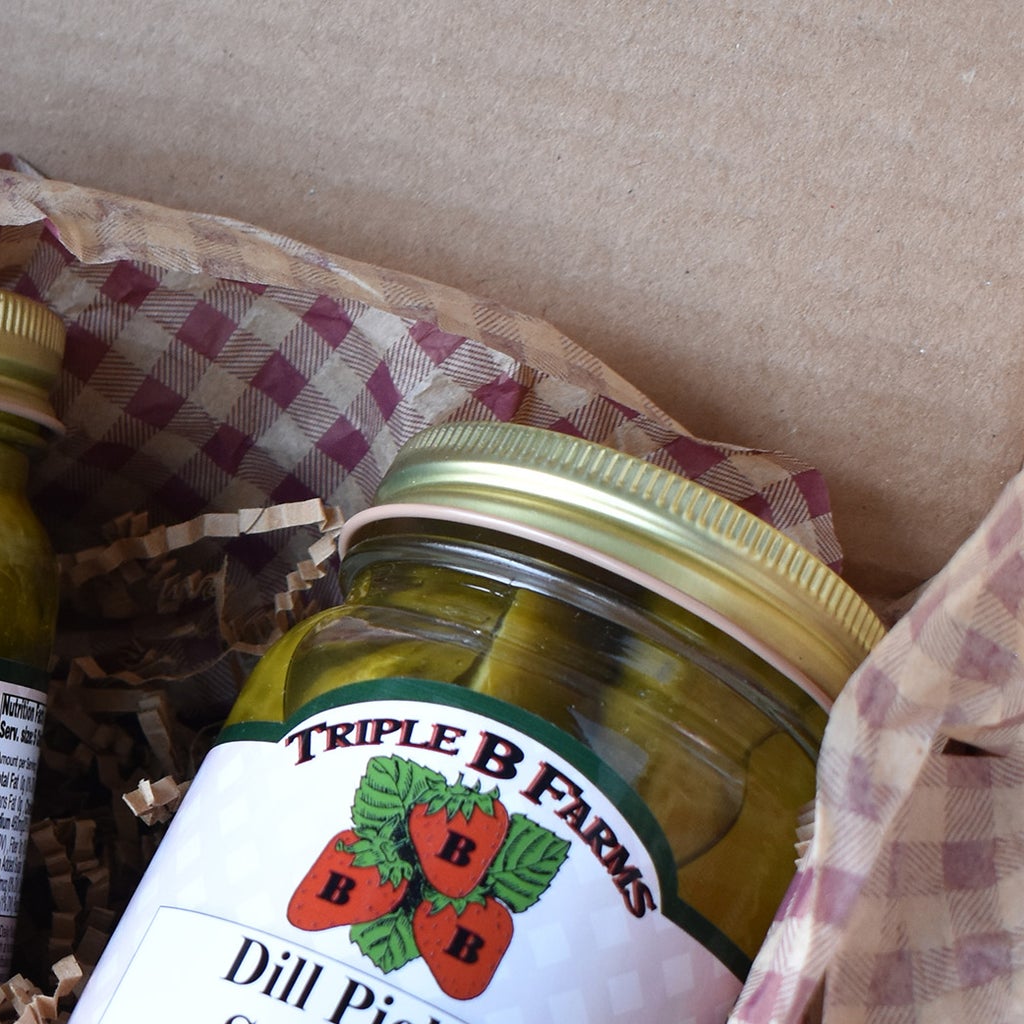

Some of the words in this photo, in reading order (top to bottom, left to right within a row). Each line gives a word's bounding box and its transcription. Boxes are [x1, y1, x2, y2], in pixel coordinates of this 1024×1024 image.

[285, 718, 466, 766] TRIPLE
[466, 730, 525, 780] B
[519, 761, 658, 919] FARMS
[435, 830, 476, 867] B
[316, 869, 357, 906] B
[443, 925, 485, 965] B
[220, 935, 324, 1011] Dill
